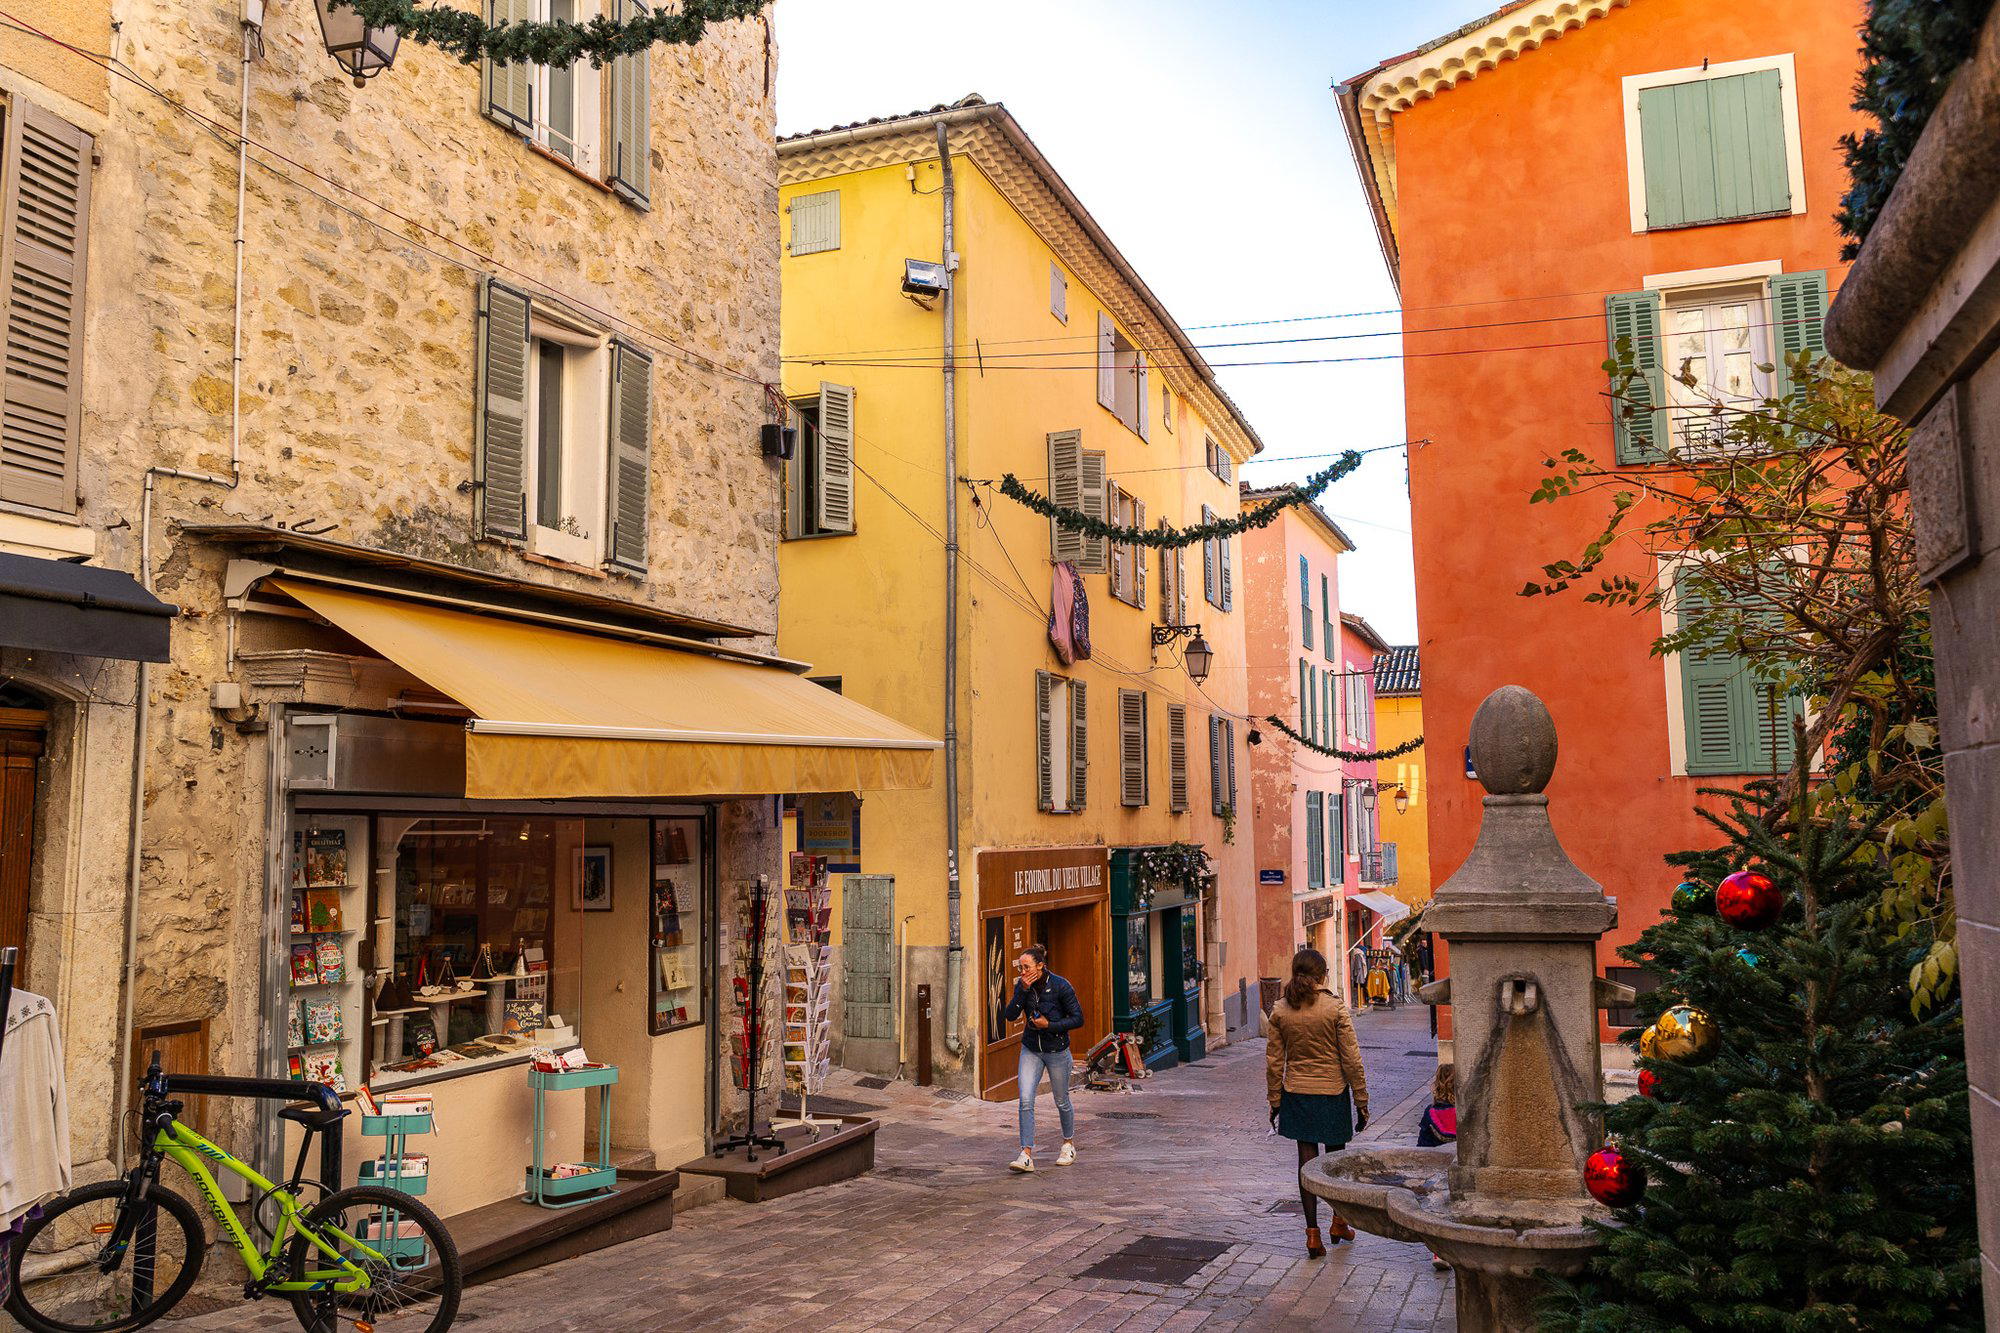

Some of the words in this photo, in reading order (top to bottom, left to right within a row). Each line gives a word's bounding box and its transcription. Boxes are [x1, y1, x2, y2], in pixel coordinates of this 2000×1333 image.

[1015, 870, 1024, 895] LE
[1024, 868, 1052, 894] FOURNIL
[1052, 868, 1061, 892] DU
[1062, 866, 1080, 890] VIEUX
[1080, 864, 1102, 888] VILLAGE
[192, 1172, 244, 1250] ROCKRIDER
